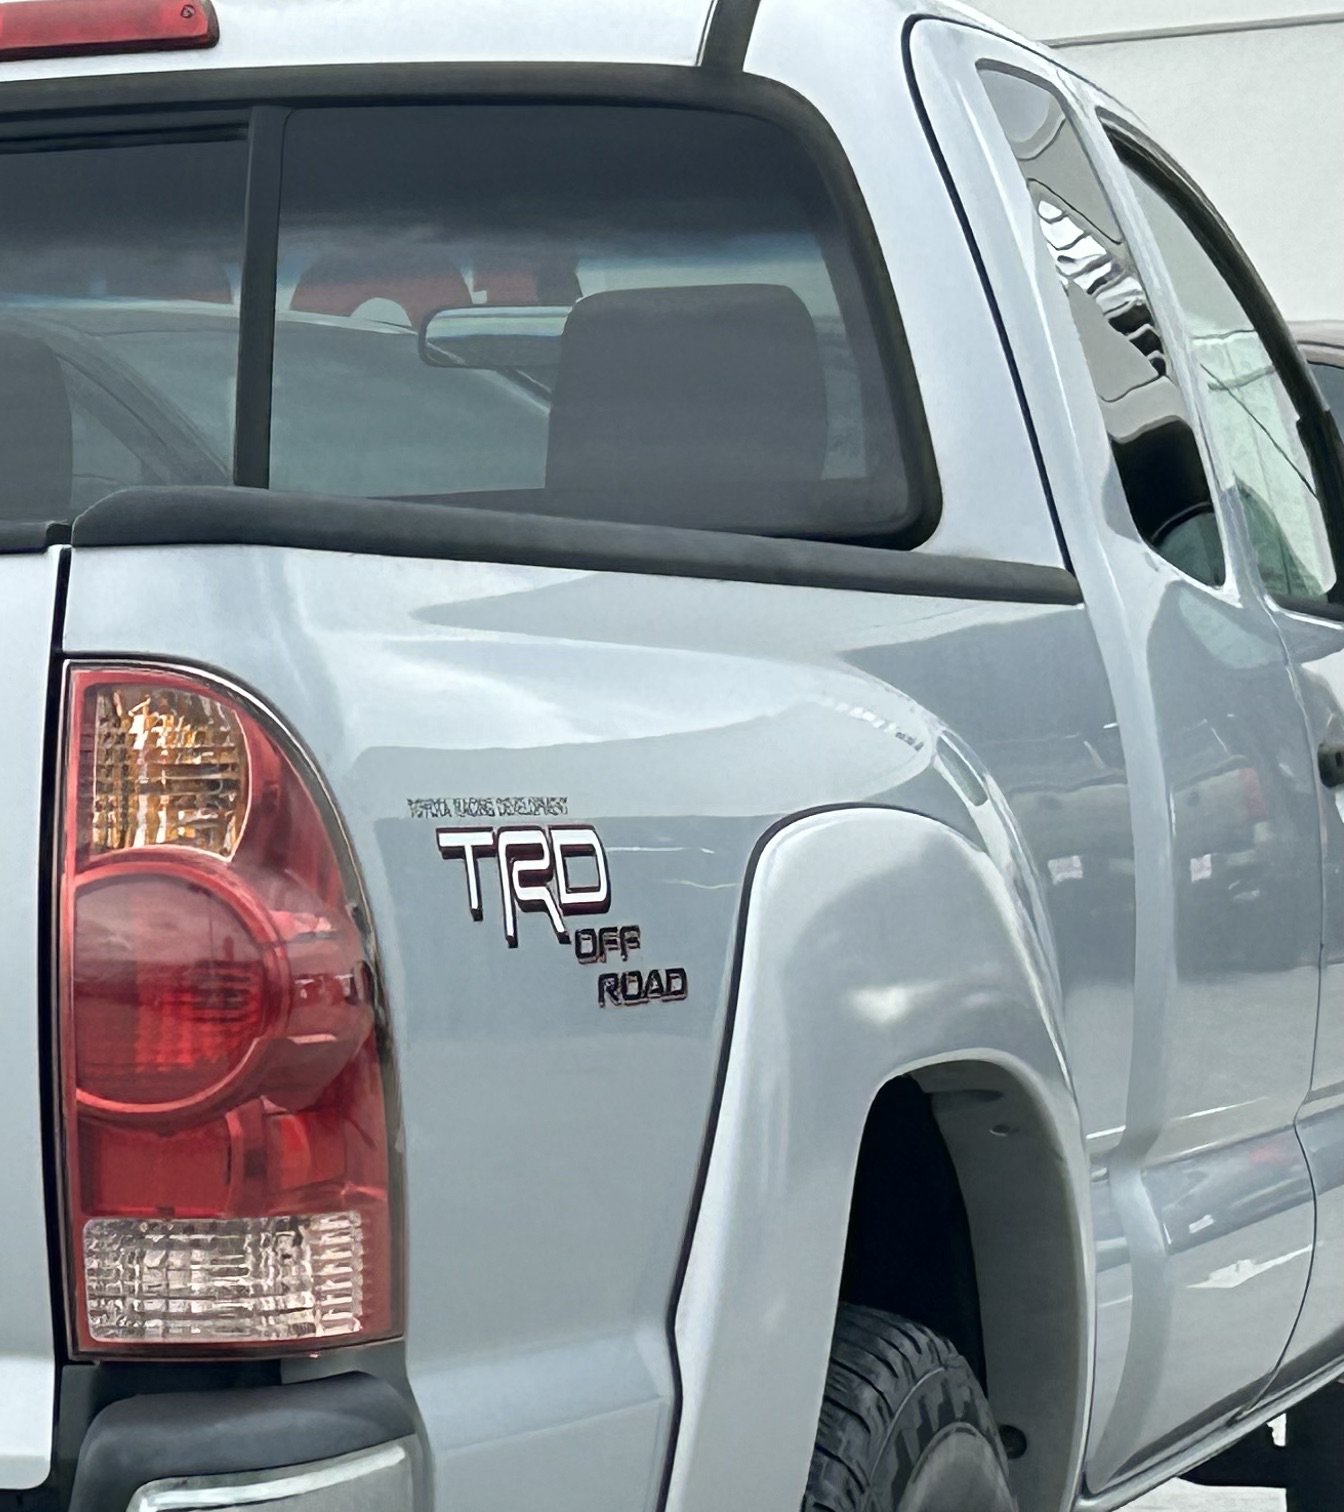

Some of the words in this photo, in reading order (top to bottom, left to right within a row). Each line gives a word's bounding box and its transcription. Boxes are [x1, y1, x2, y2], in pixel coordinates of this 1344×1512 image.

[435, 825, 611, 948] TRD
[574, 925, 641, 964] OFF
[598, 967, 689, 1009] ROAD
